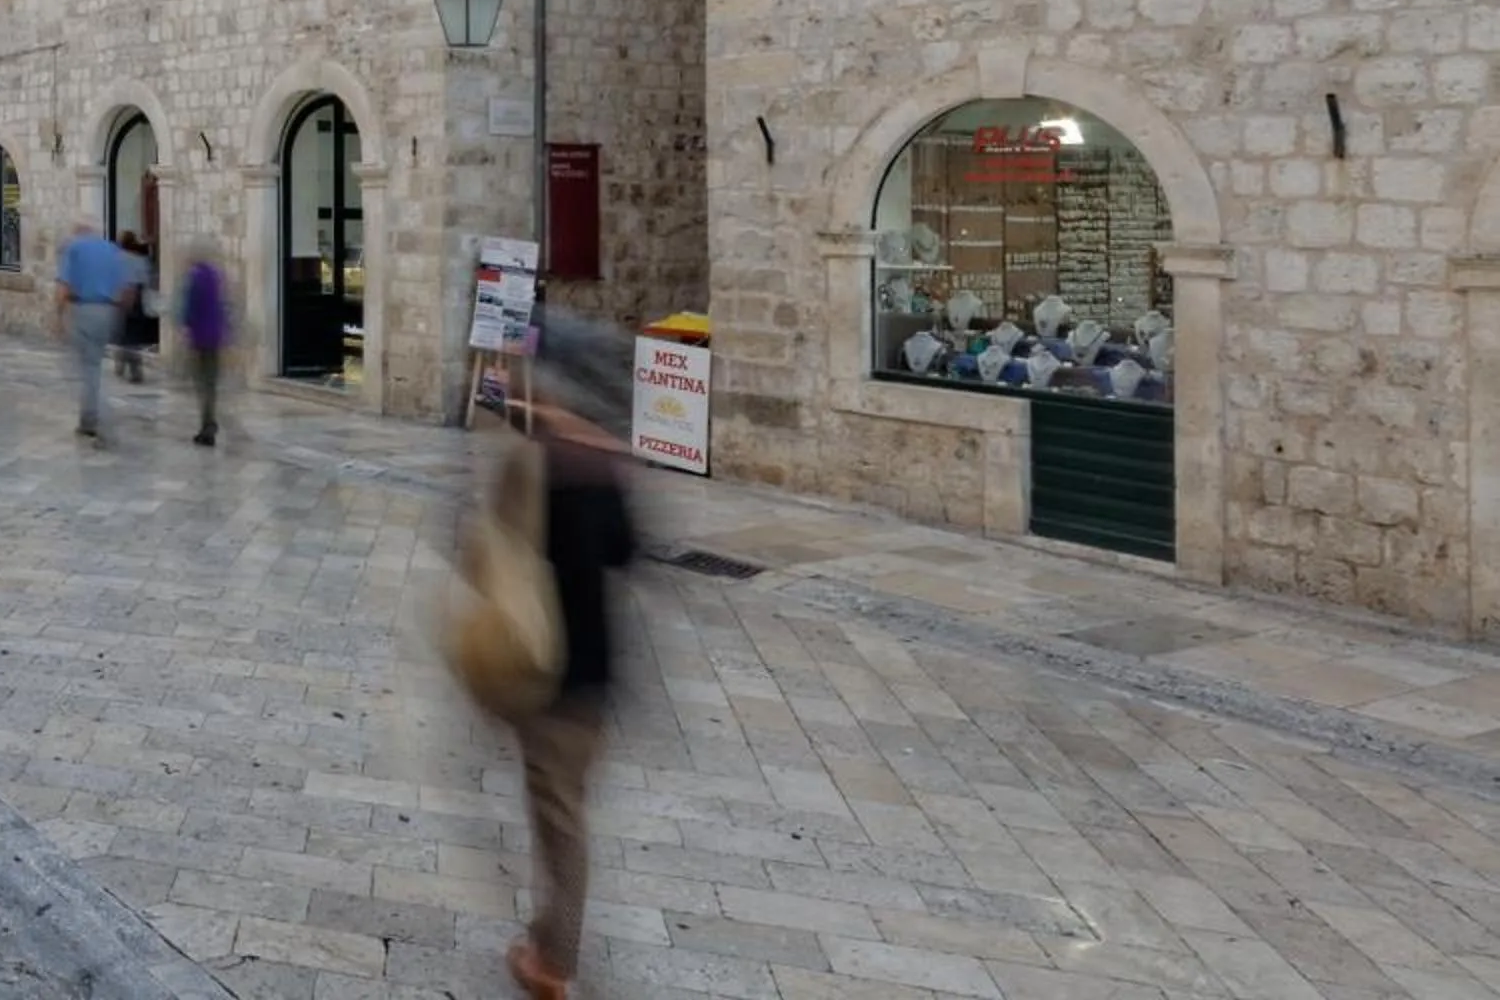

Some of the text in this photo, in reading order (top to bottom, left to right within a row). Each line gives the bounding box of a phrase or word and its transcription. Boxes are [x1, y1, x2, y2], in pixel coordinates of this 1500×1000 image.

[974, 126, 1063, 153] PLUS
[654, 350, 688, 370] MEX
[636, 367, 706, 394] CANTINA
[639, 435, 703, 464] PIZZERIA
